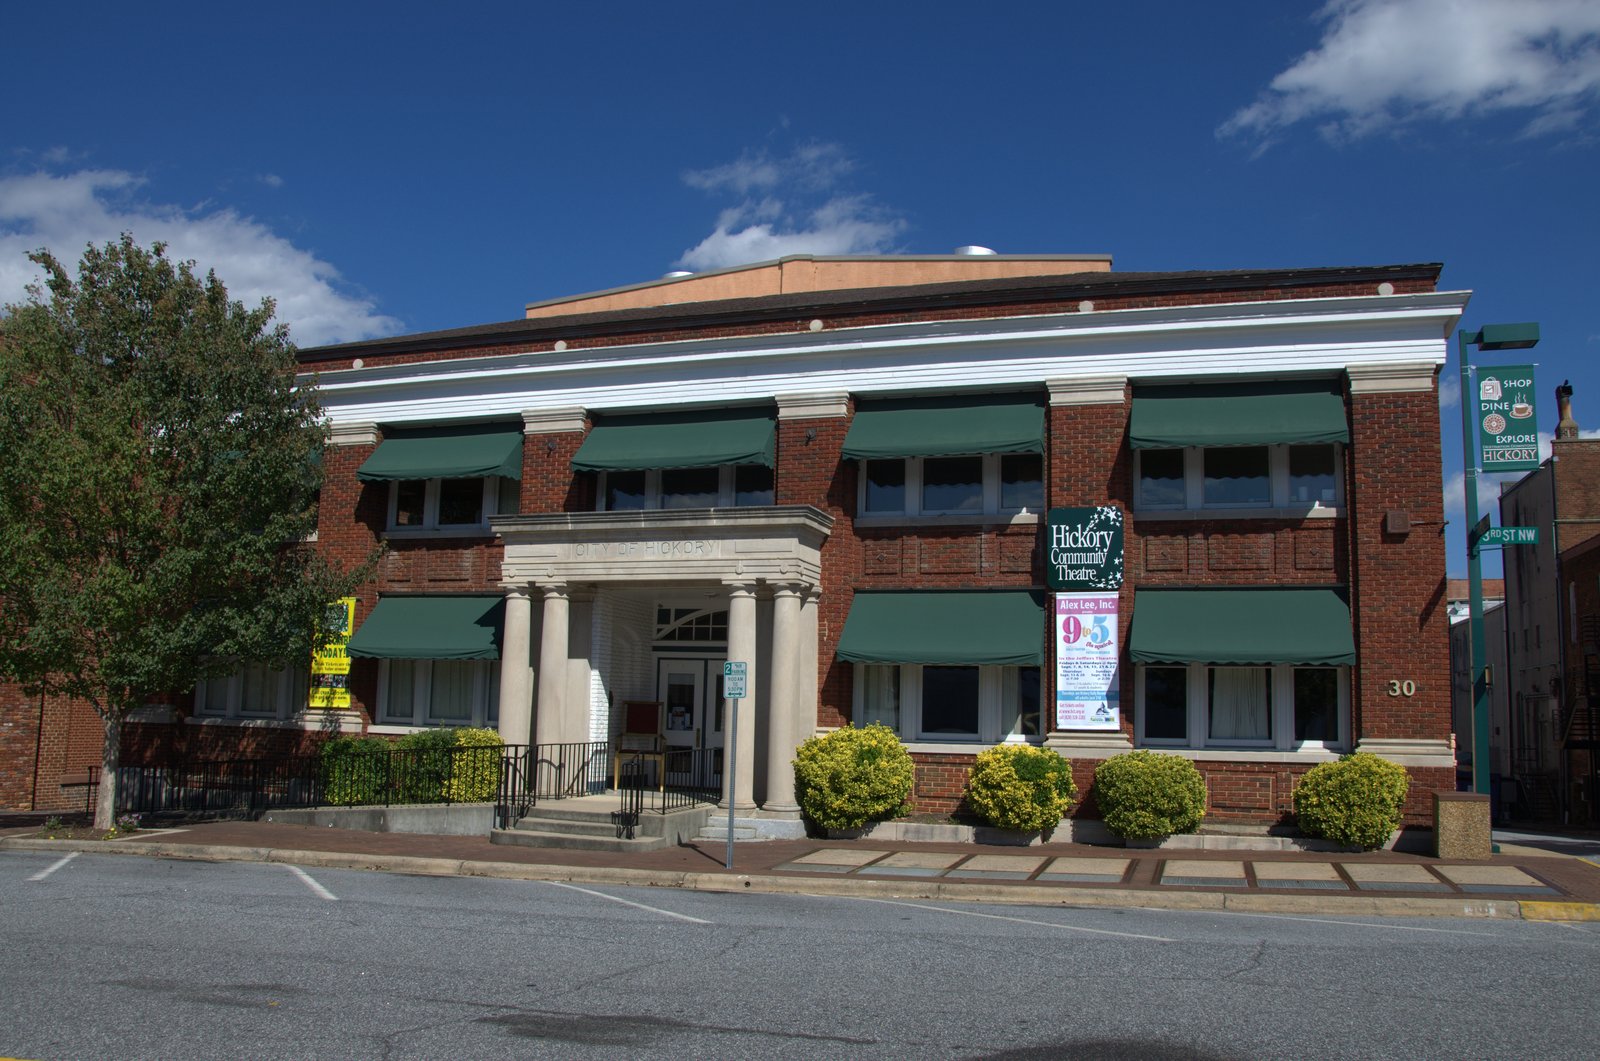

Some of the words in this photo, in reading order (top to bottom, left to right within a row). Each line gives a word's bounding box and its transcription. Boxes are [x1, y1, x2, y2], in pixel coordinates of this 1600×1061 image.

[1503, 379, 1532, 388] SHOP
[1481, 401, 1510, 411] DINE
[1496, 434, 1536, 444] EXPLORE
[1483, 449, 1537, 461] HICKORY
[1051, 523, 1114, 552] Hickory
[1502, 529, 1516, 541] ST
[1518, 529, 1536, 541] NW
[575, 543, 610, 557] CITY
[618, 542, 639, 555] OF
[645, 540, 716, 555] HICKORY
[1051, 547, 1108, 568] Community
[1056, 564, 1097, 581] Theatre
[1060, 600, 1079, 609] Alex
[1080, 600, 1098, 610] Lee,
[1099, 599, 1115, 609] Inc.
[1062, 615, 1082, 644] 9
[1082, 626, 1092, 638] to
[1090, 615, 1110, 644] 5
[319, 647, 347, 659] TODAY!
[725, 664, 731, 674] 2
[1388, 679, 1416, 697] 30
